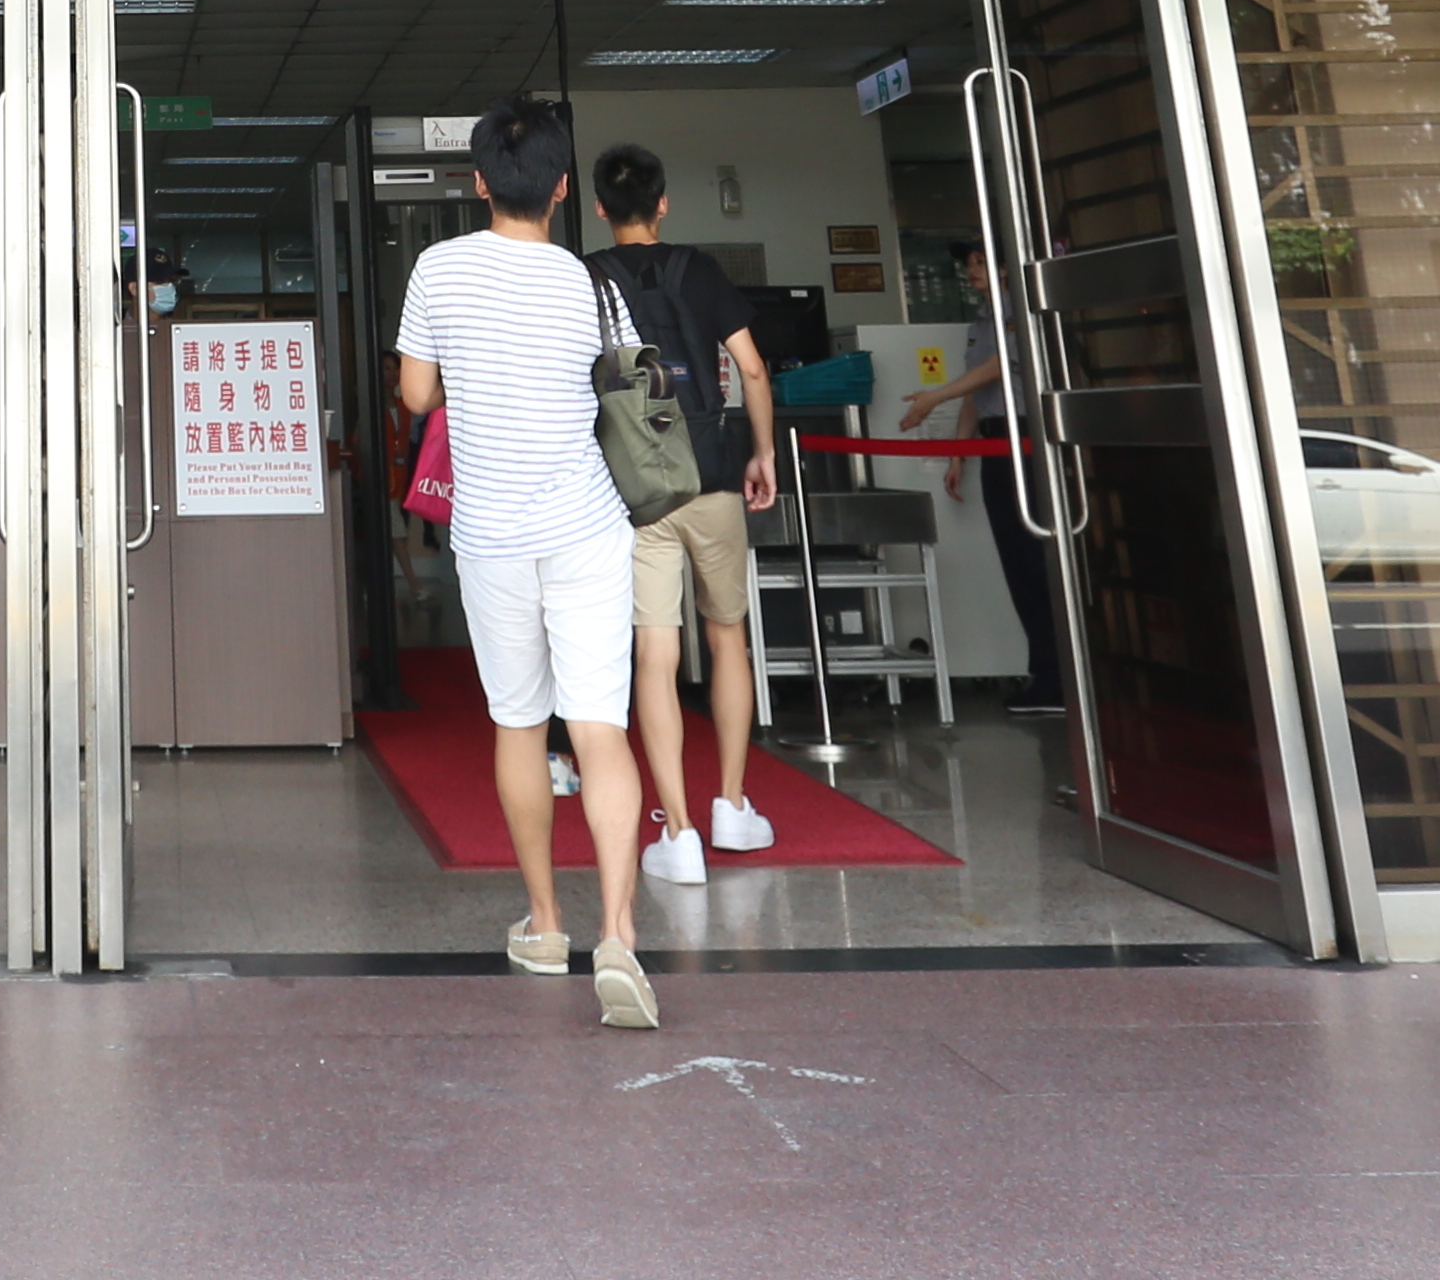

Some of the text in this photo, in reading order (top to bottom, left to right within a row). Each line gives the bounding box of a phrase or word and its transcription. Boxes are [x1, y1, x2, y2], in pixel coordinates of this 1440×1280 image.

[430, 121, 447, 137] 入
[182, 339, 304, 373] 請將手提包
[184, 380, 306, 413] 隨身物品
[185, 420, 309, 454] 放置籃內檢查
[187, 461, 313, 472] Please Put Your Hand Bag
[187, 473, 309, 484] and Personal Possessions
[187, 485, 313, 496] Into the Box for Checking
